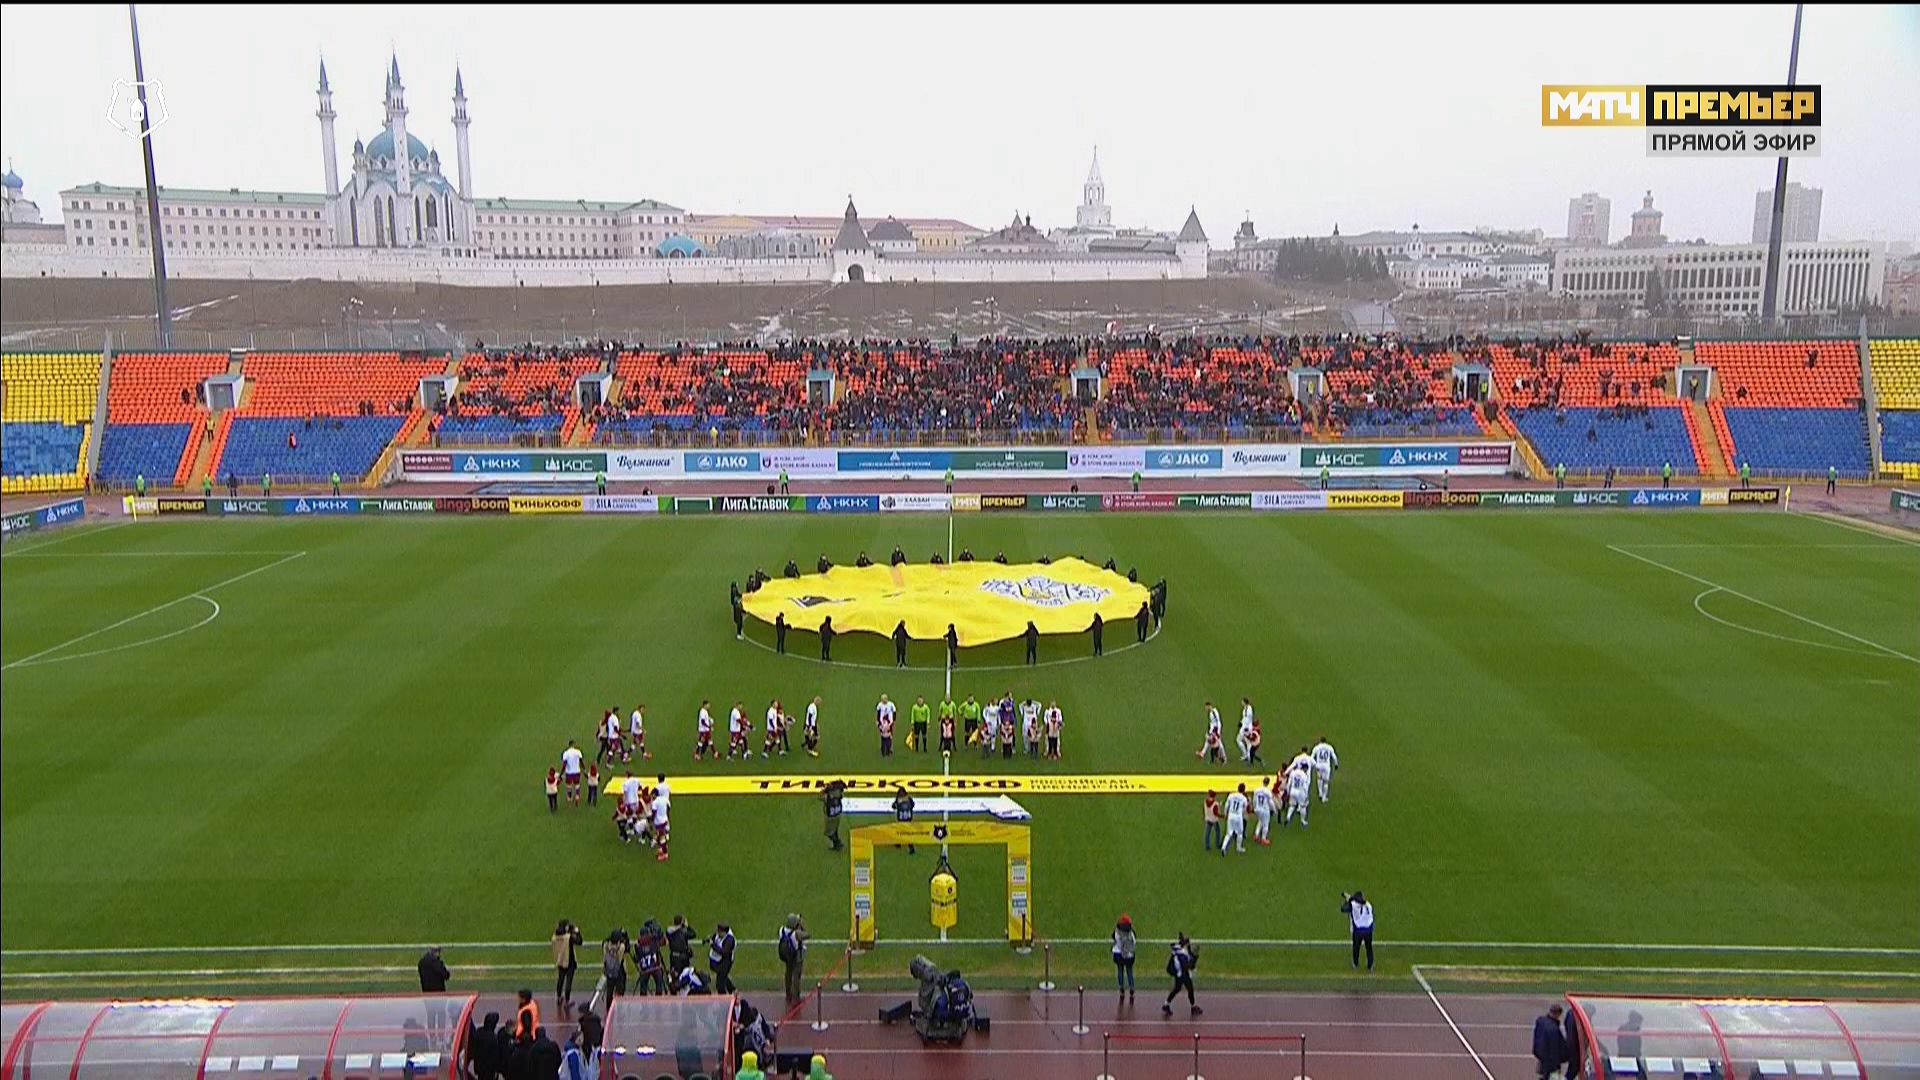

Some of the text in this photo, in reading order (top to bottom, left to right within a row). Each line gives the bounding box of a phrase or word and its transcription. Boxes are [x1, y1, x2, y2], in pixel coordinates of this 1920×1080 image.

[715, 457, 748, 468] JAKO
[1175, 453, 1209, 465] JAKO
[982, 496, 1026, 507] ПРЕМЬЕР
[1330, 494, 1400, 503] ТИНЬКОФФ
[1730, 491, 1777, 501] ПРЕМЬЕР
[159, 500, 205, 511] ПРЕМЬЕР
[512, 500, 582, 509] ТИНЬКОФФ
